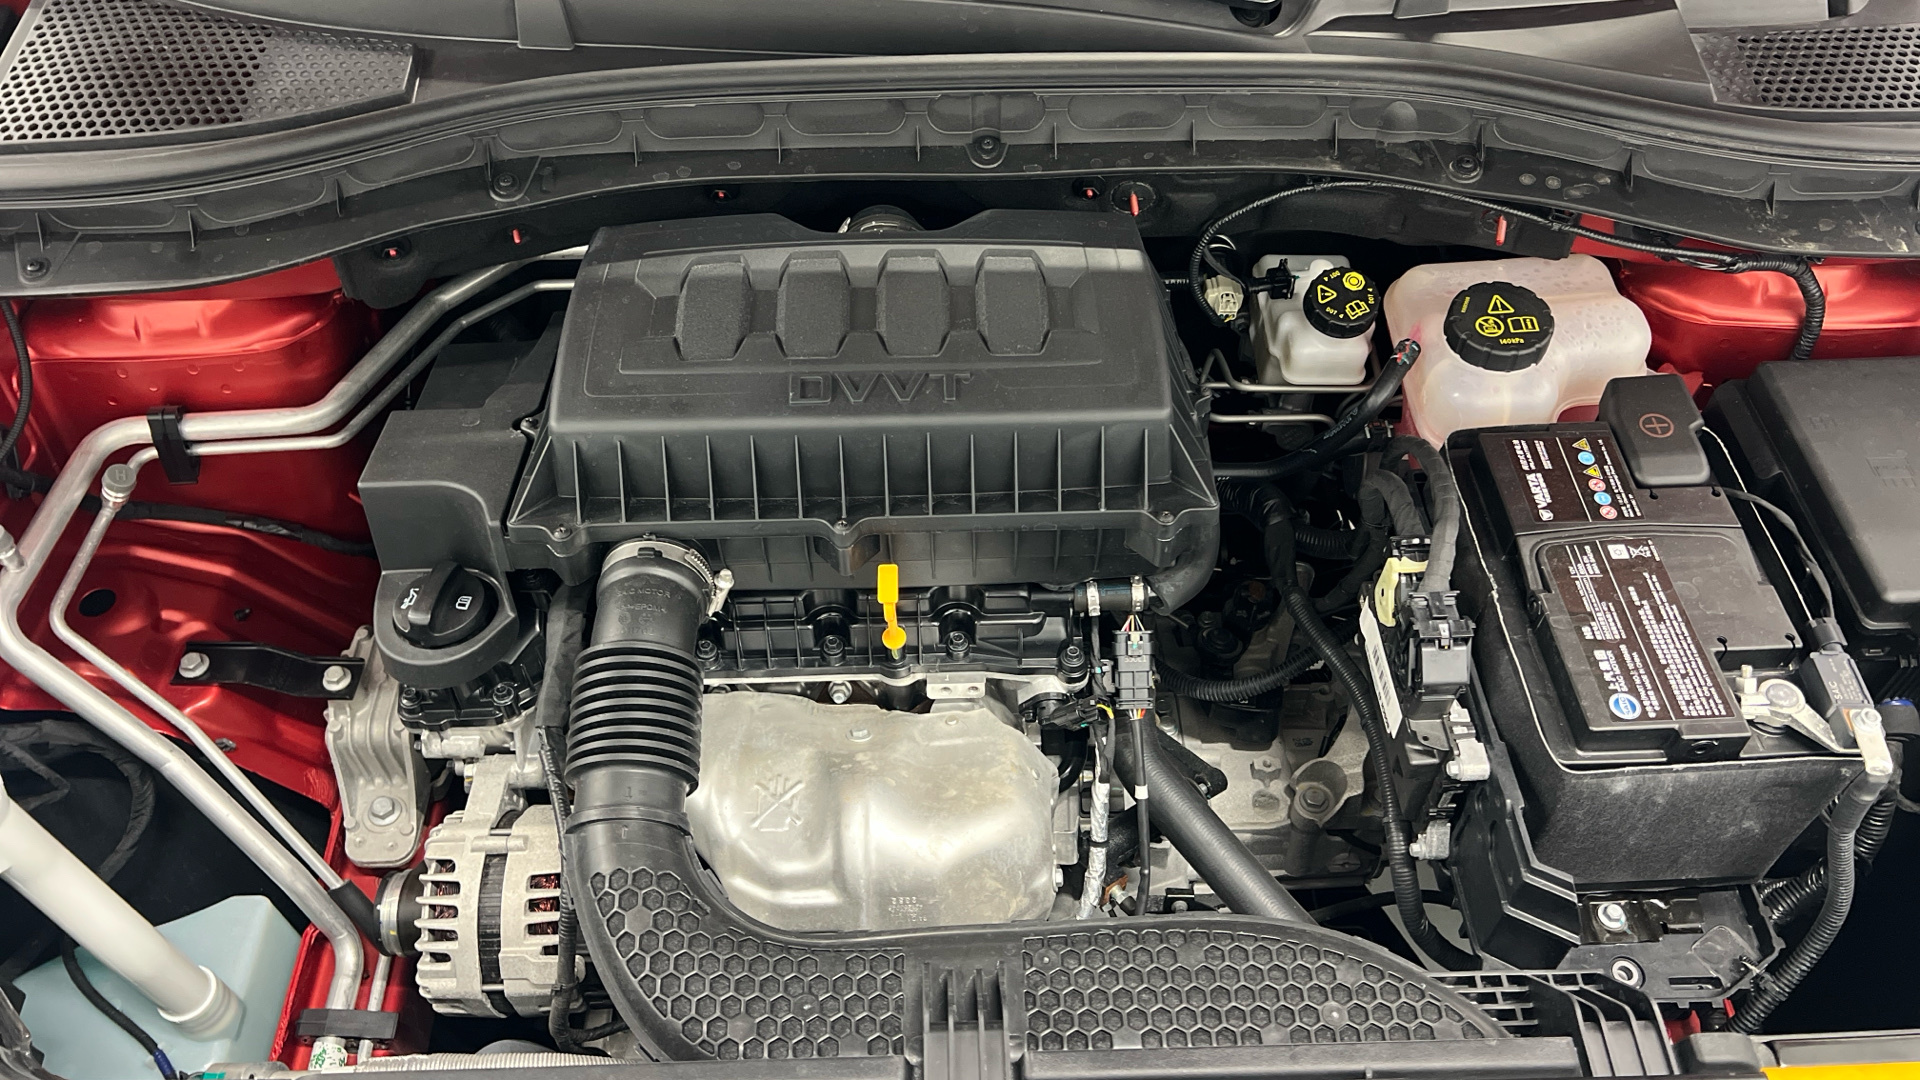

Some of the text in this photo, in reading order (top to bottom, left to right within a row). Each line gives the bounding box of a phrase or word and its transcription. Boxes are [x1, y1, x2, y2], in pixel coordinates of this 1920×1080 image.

[789, 372, 972, 405] DVVT
[116, 470, 127, 480] H
[1526, 472, 1548, 508] VARTA
[1606, 650, 1620, 674] MOTOR
[1616, 676, 1628, 692] SAIC
